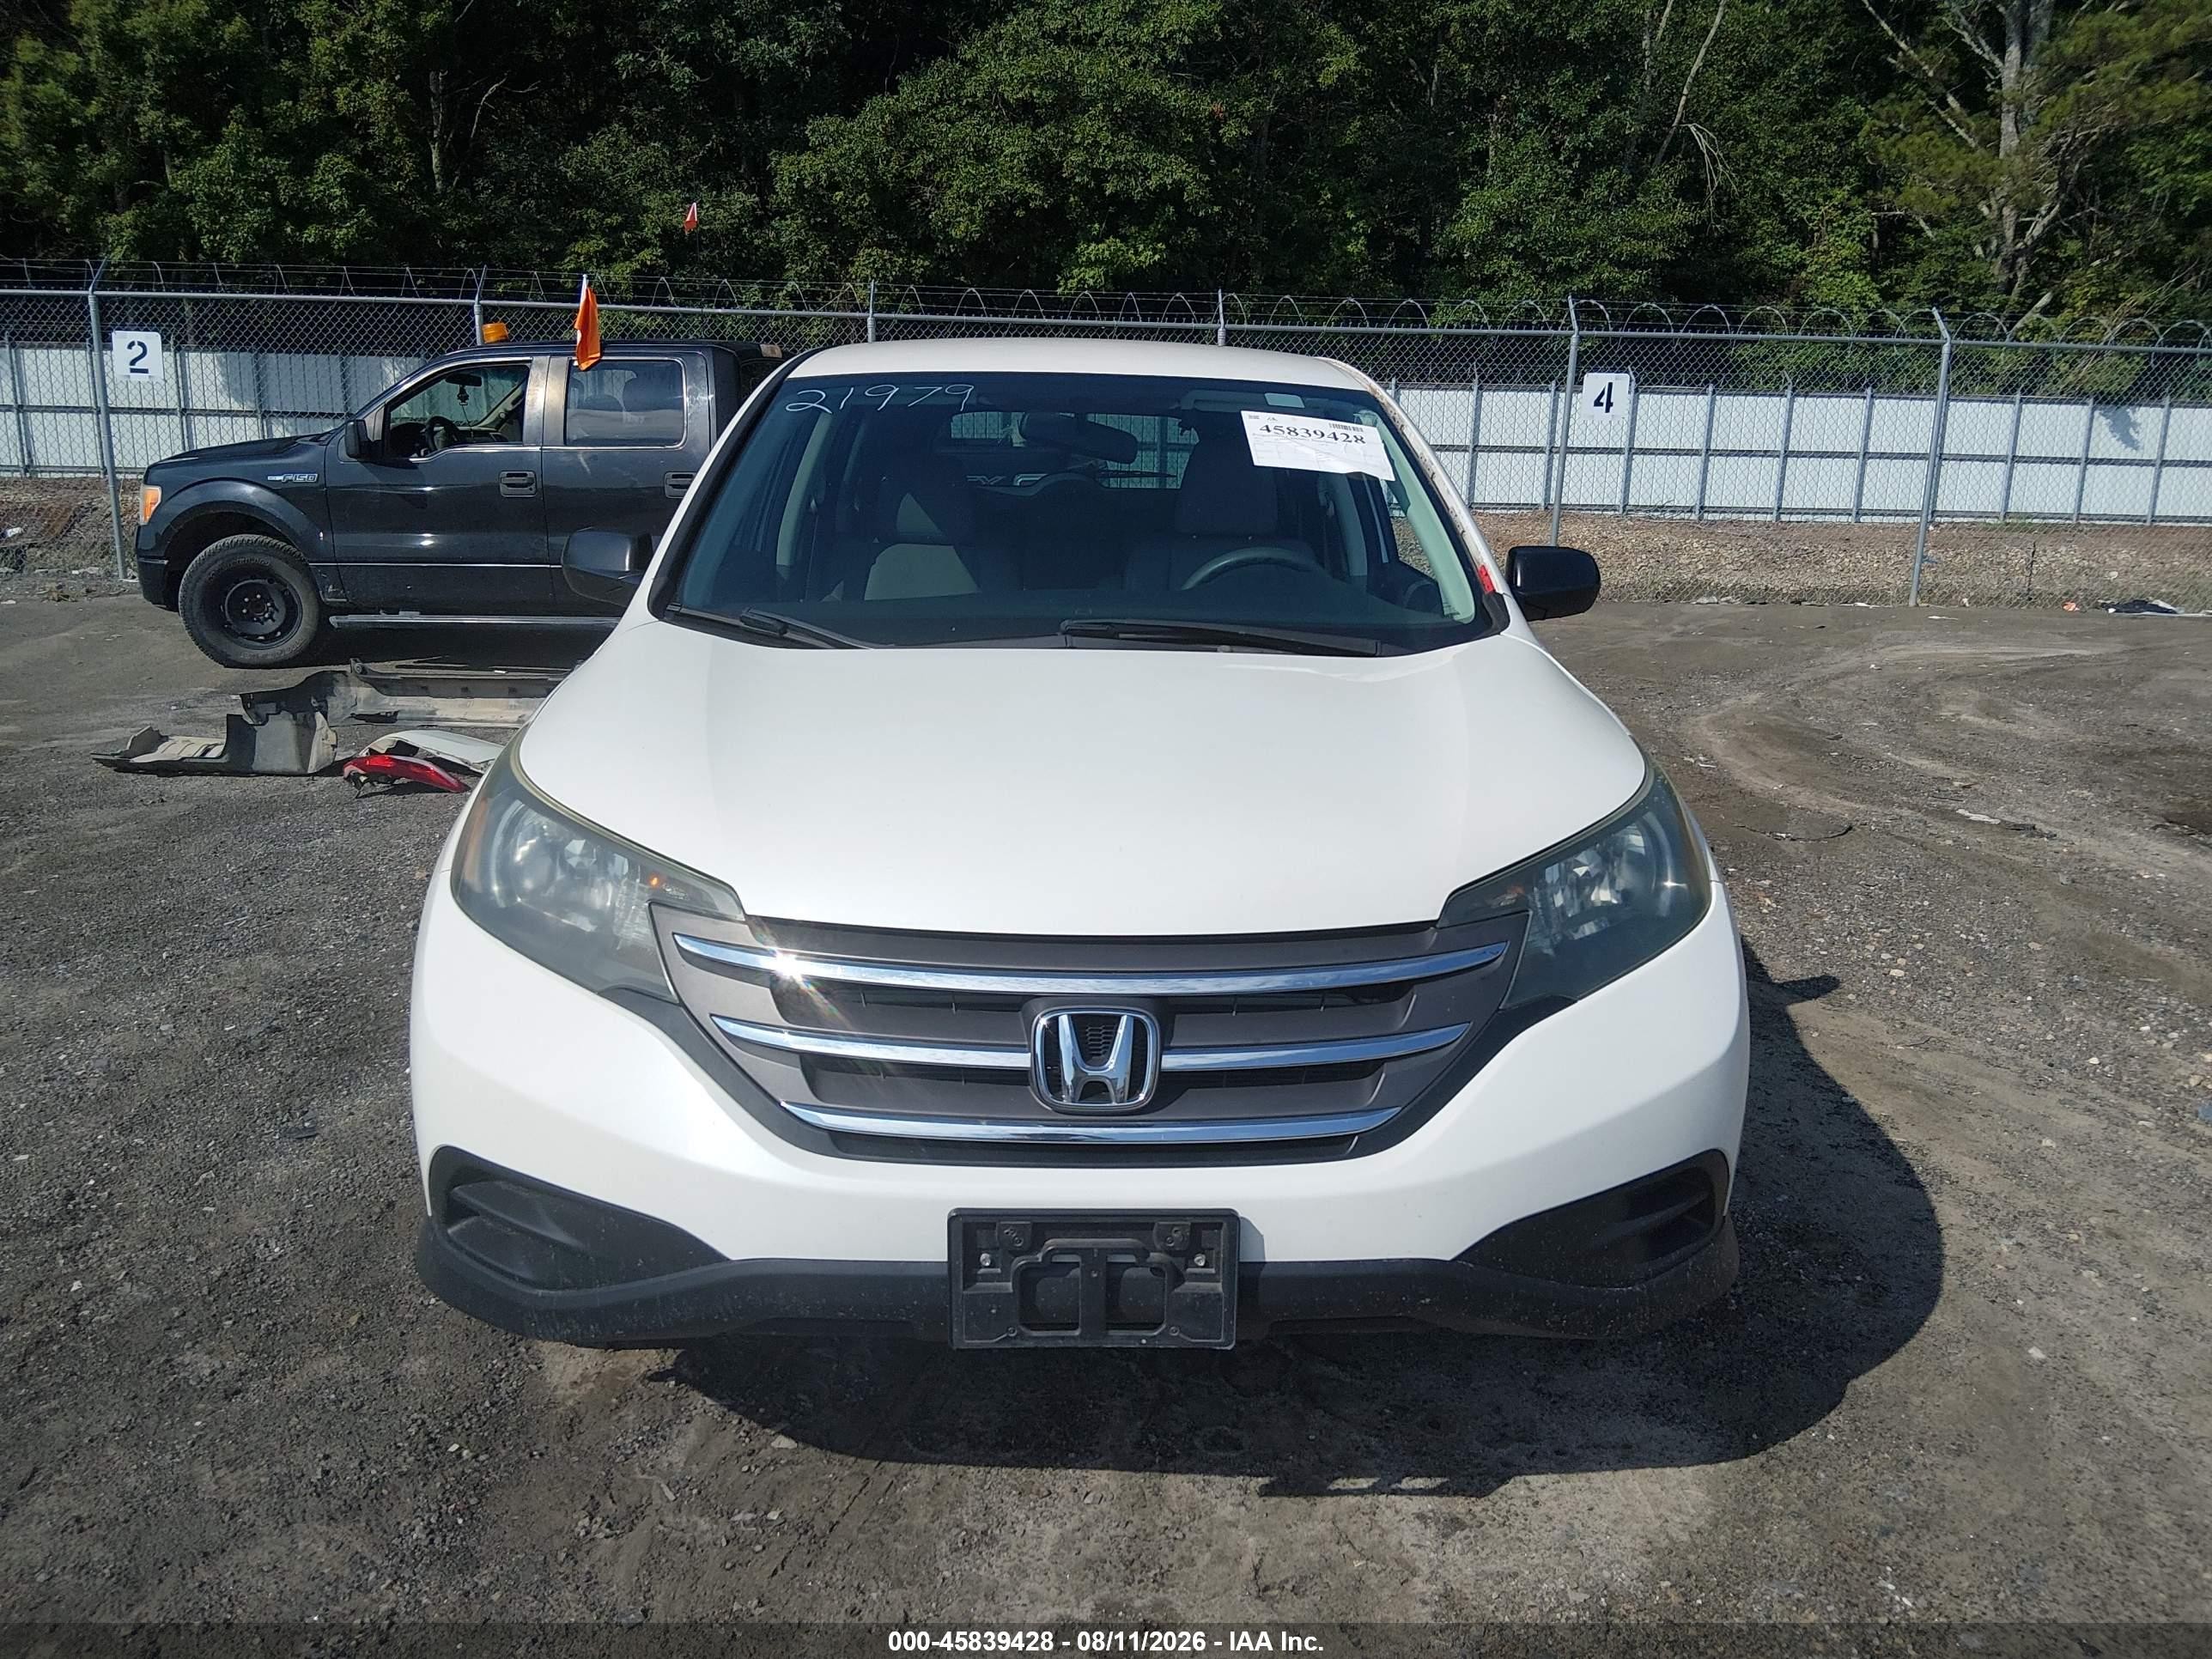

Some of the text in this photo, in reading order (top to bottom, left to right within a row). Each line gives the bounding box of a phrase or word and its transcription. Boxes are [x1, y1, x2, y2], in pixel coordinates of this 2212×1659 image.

[126, 340, 149, 374] 2
[785, 384, 975, 415] 21979
[1593, 381, 1614, 414] 4
[1259, 423, 1367, 445] 45839428
